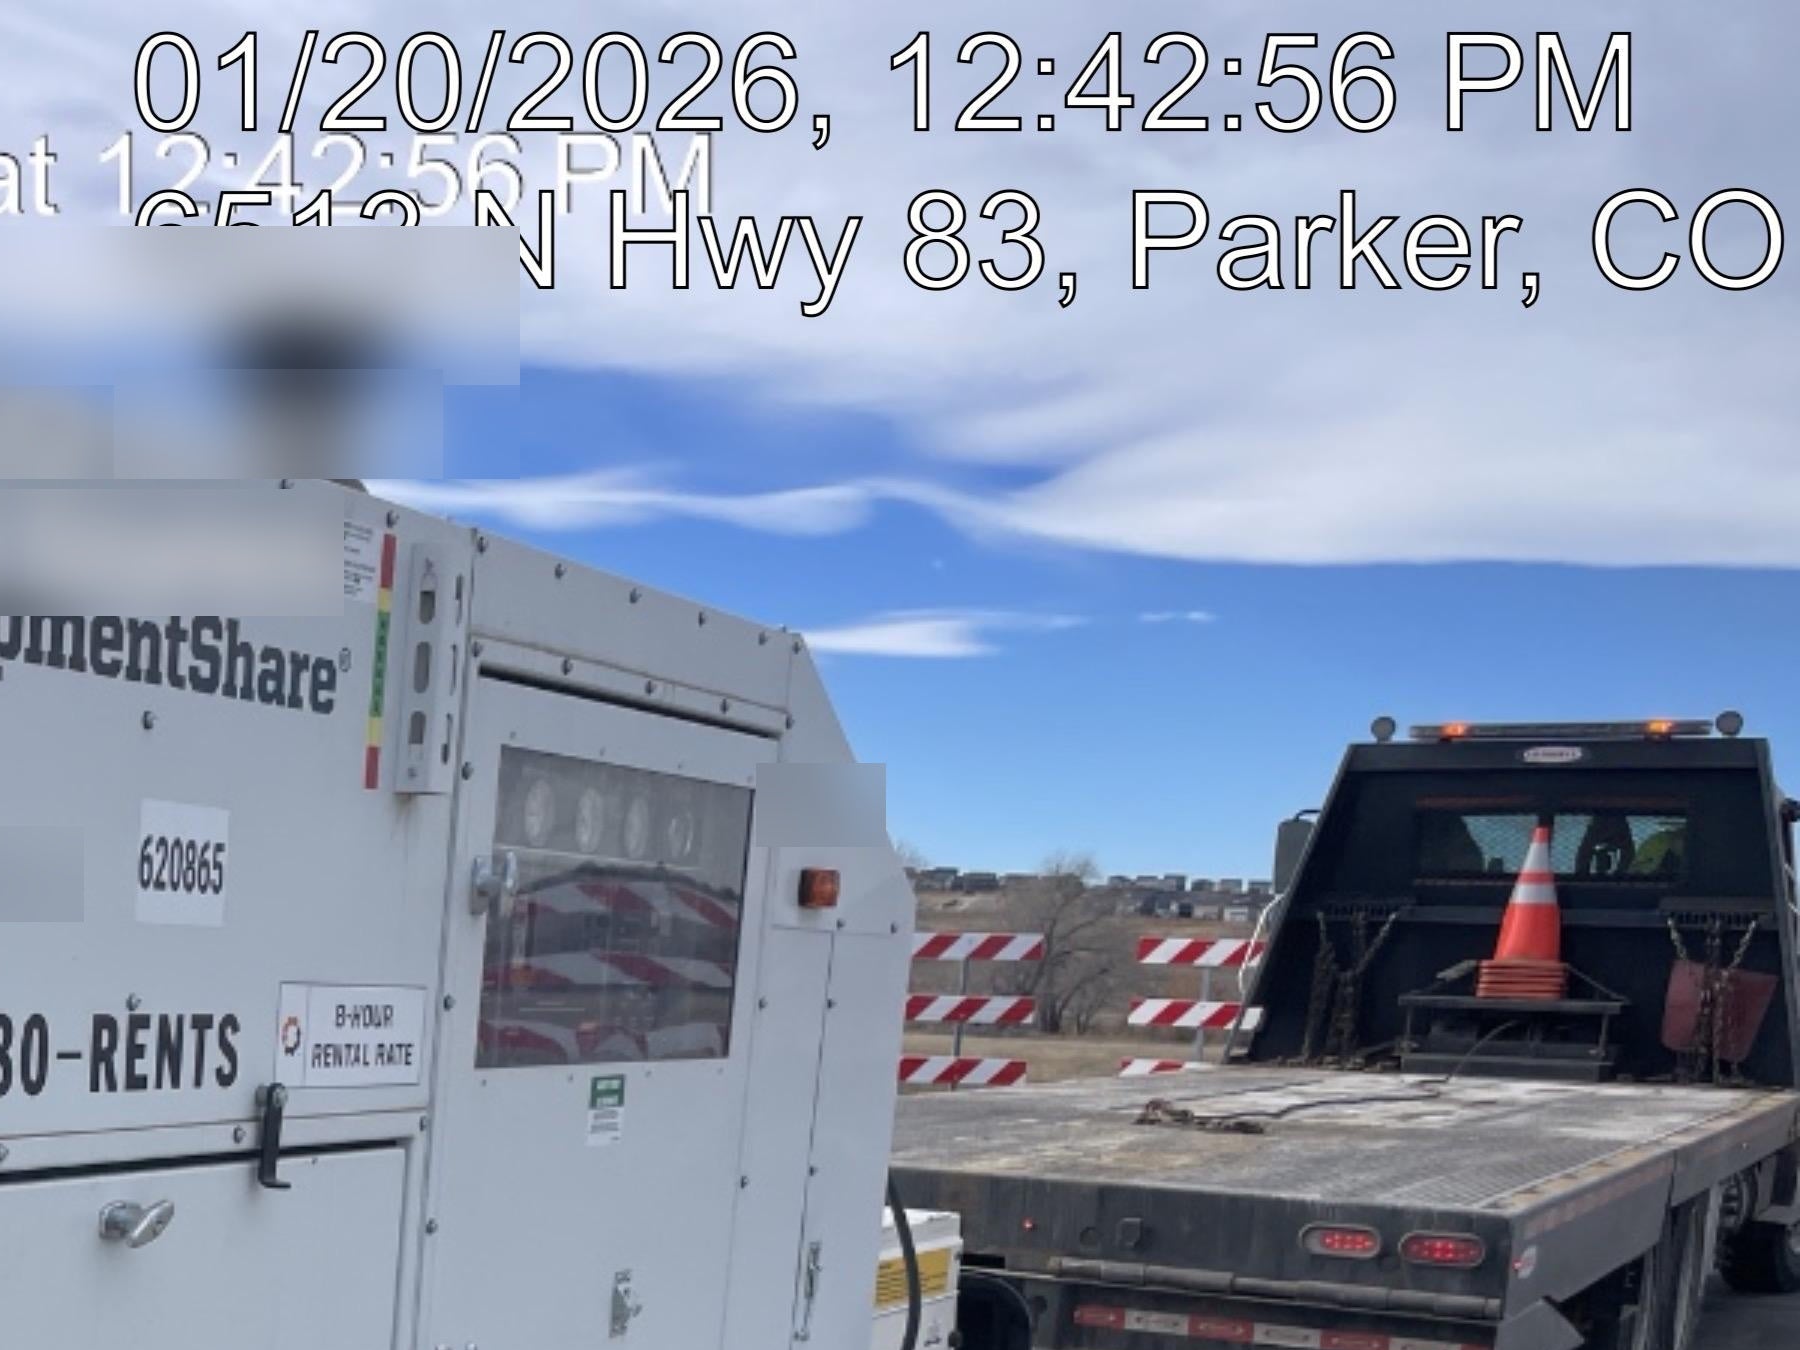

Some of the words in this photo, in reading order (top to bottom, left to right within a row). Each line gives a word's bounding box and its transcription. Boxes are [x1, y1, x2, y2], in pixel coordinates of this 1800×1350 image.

[137, 835, 226, 896] 620865
[311, 1042, 370, 1069] RENTAL
[375, 1042, 414, 1067] RATE
